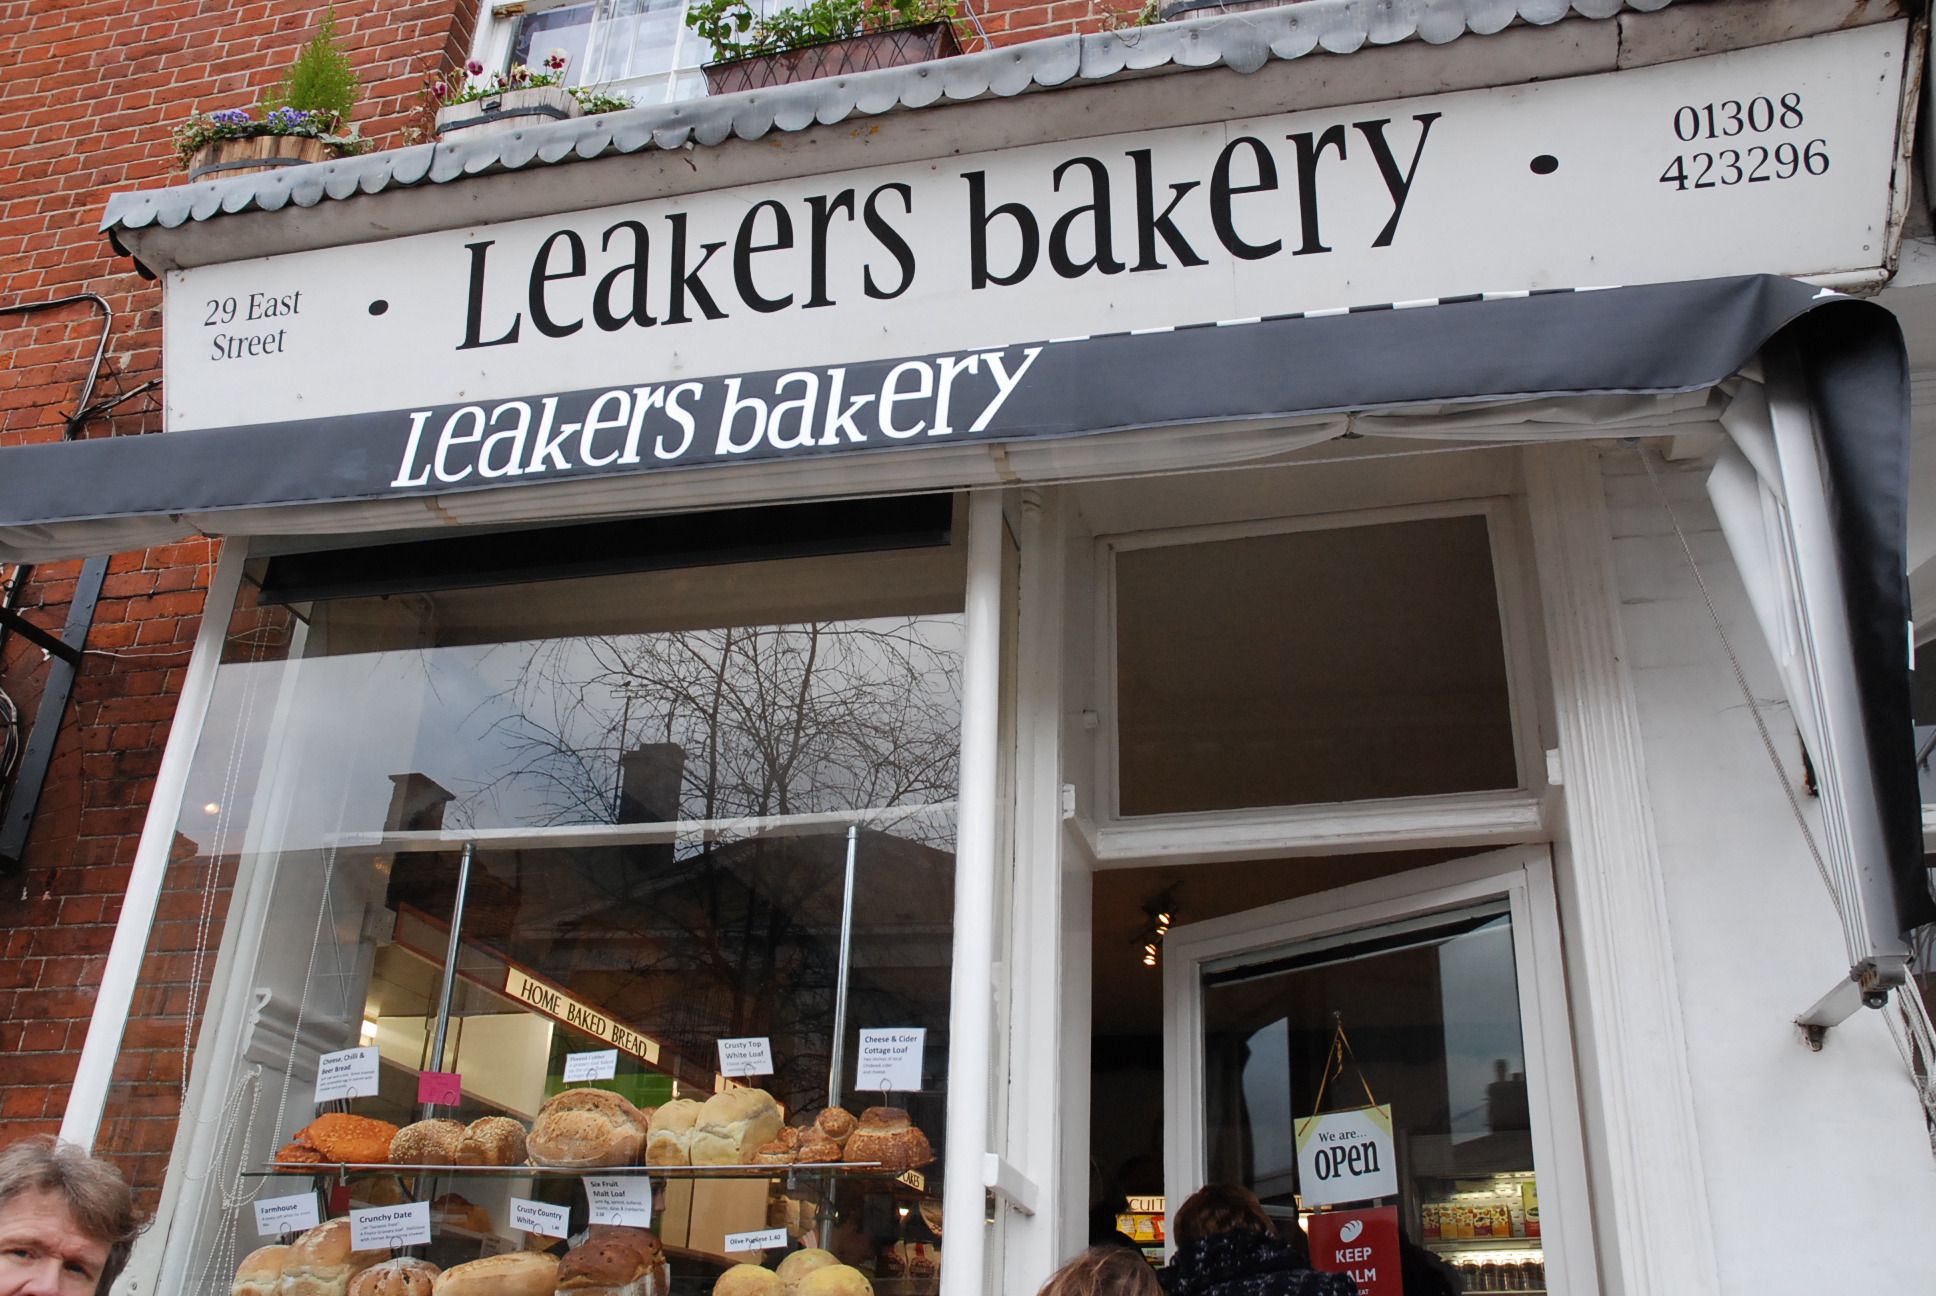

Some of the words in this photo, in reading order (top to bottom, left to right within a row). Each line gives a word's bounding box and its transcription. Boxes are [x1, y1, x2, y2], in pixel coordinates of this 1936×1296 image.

[1673, 92, 1804, 142] 01308
[1660, 138, 1831, 192] 423296
[455, 182, 916, 351] Leakers
[960, 112, 1443, 291] bakery
[203, 297, 237, 328] 29
[247, 289, 302, 322] East
[211, 328, 287, 362] Street
[390, 379, 704, 489] Leakers
[715, 345, 1044, 456] bakery
[521, 979, 562, 1016] HOME
[566, 1003, 607, 1036] BAKED
[611, 1023, 648, 1059] BREAD
[864, 1035, 890, 1043] Cheese
[864, 1047, 891, 1055] Cottage
[892, 1046, 908, 1054] Loaf
[1318, 1132, 1336, 1143] We
[261, 1204, 298, 1214] Farmhouse
[516, 1204, 537, 1216] Crusty
[537, 1208, 562, 1221] Country
[1130, 1198, 1165, 1211] CUIT
[359, 1213, 392, 1224] Crunchy
[393, 1211, 413, 1219] Date
[516, 1215, 535, 1226] White
[729, 1237, 744, 1245] Olive
[1335, 1247, 1372, 1264] KEEP
[1346, 1267, 1377, 1283] ALM
